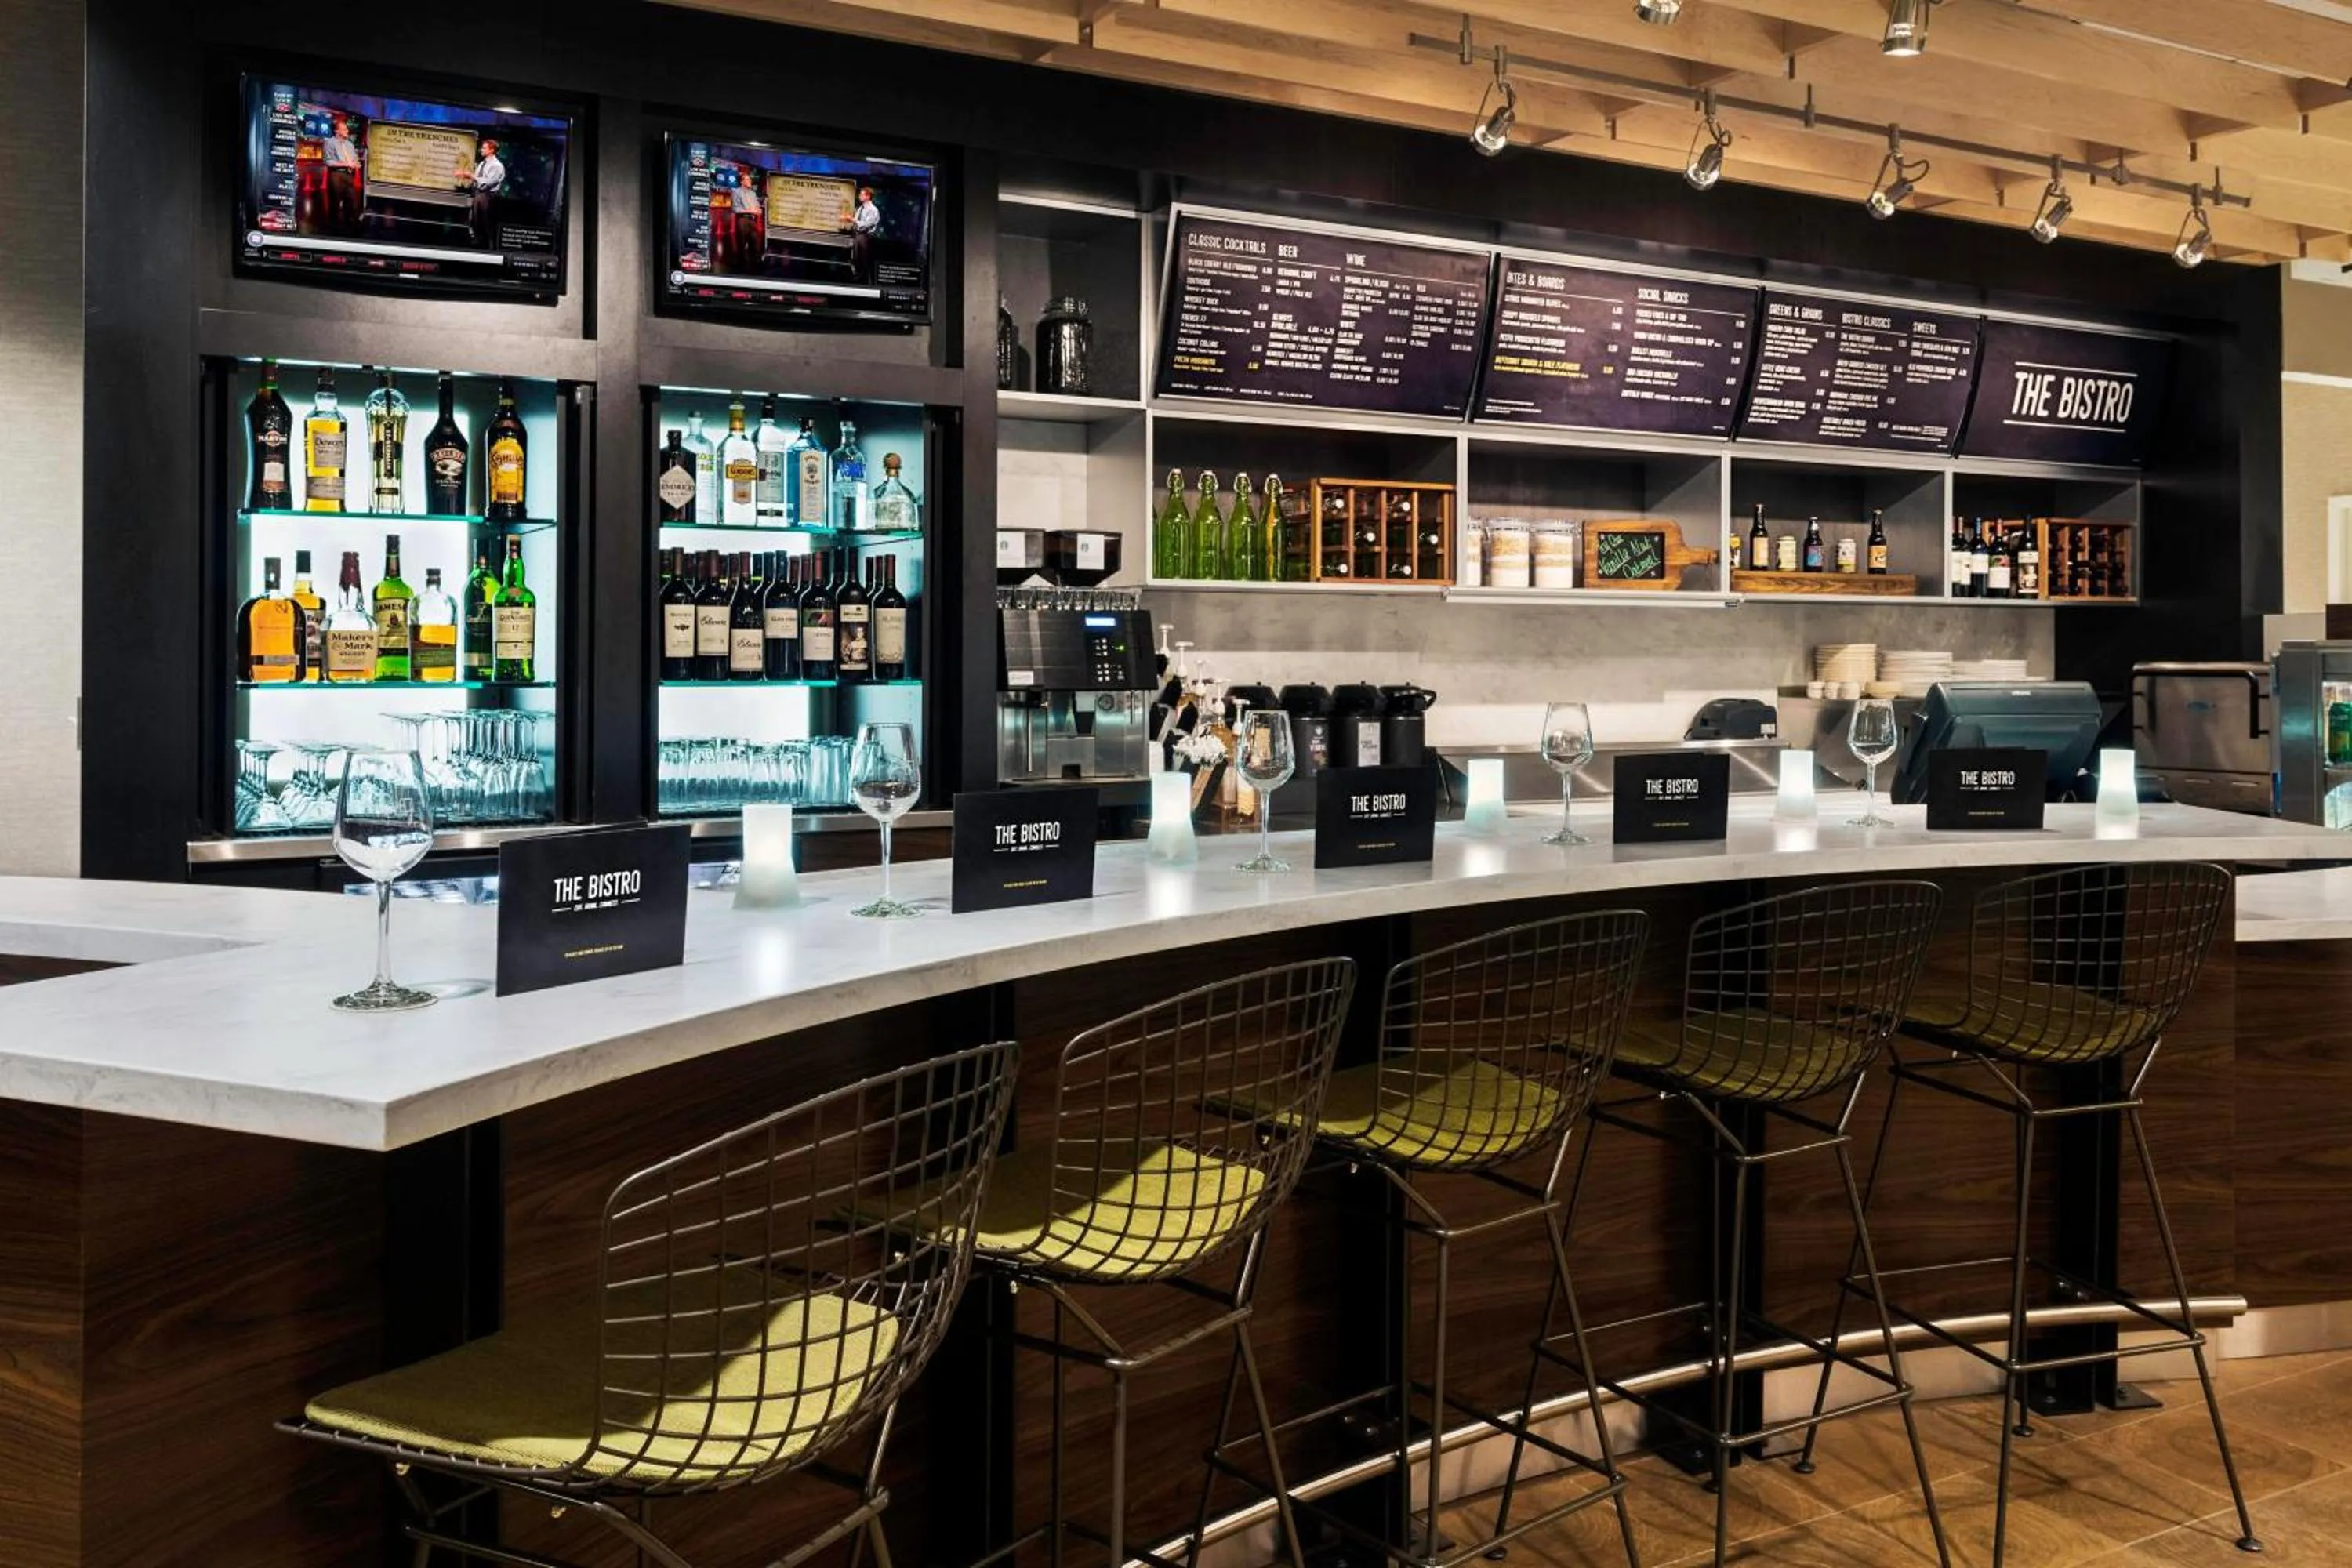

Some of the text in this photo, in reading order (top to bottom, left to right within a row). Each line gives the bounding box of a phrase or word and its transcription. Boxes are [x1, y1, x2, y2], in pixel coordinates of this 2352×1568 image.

[1188, 234, 1266, 254] CLASSIC COCKTAILS
[1279, 244, 1298, 258] BEER
[1506, 272, 1526, 285] BITES
[1529, 274, 1534, 285] &
[1794, 307, 1799, 318] &
[1864, 315, 1891, 329] CLASSICS
[2012, 371, 2056, 416] THE
[2056, 376, 2134, 423] BISTRO
[1646, 778, 1699, 794] THE BISTRO
[1961, 771, 2015, 785] THE BISTRO
[1351, 793, 1406, 812] THE BISTRO
[995, 821, 1060, 844] THE BISTRO
[554, 869, 641, 902] THE BISTRO
